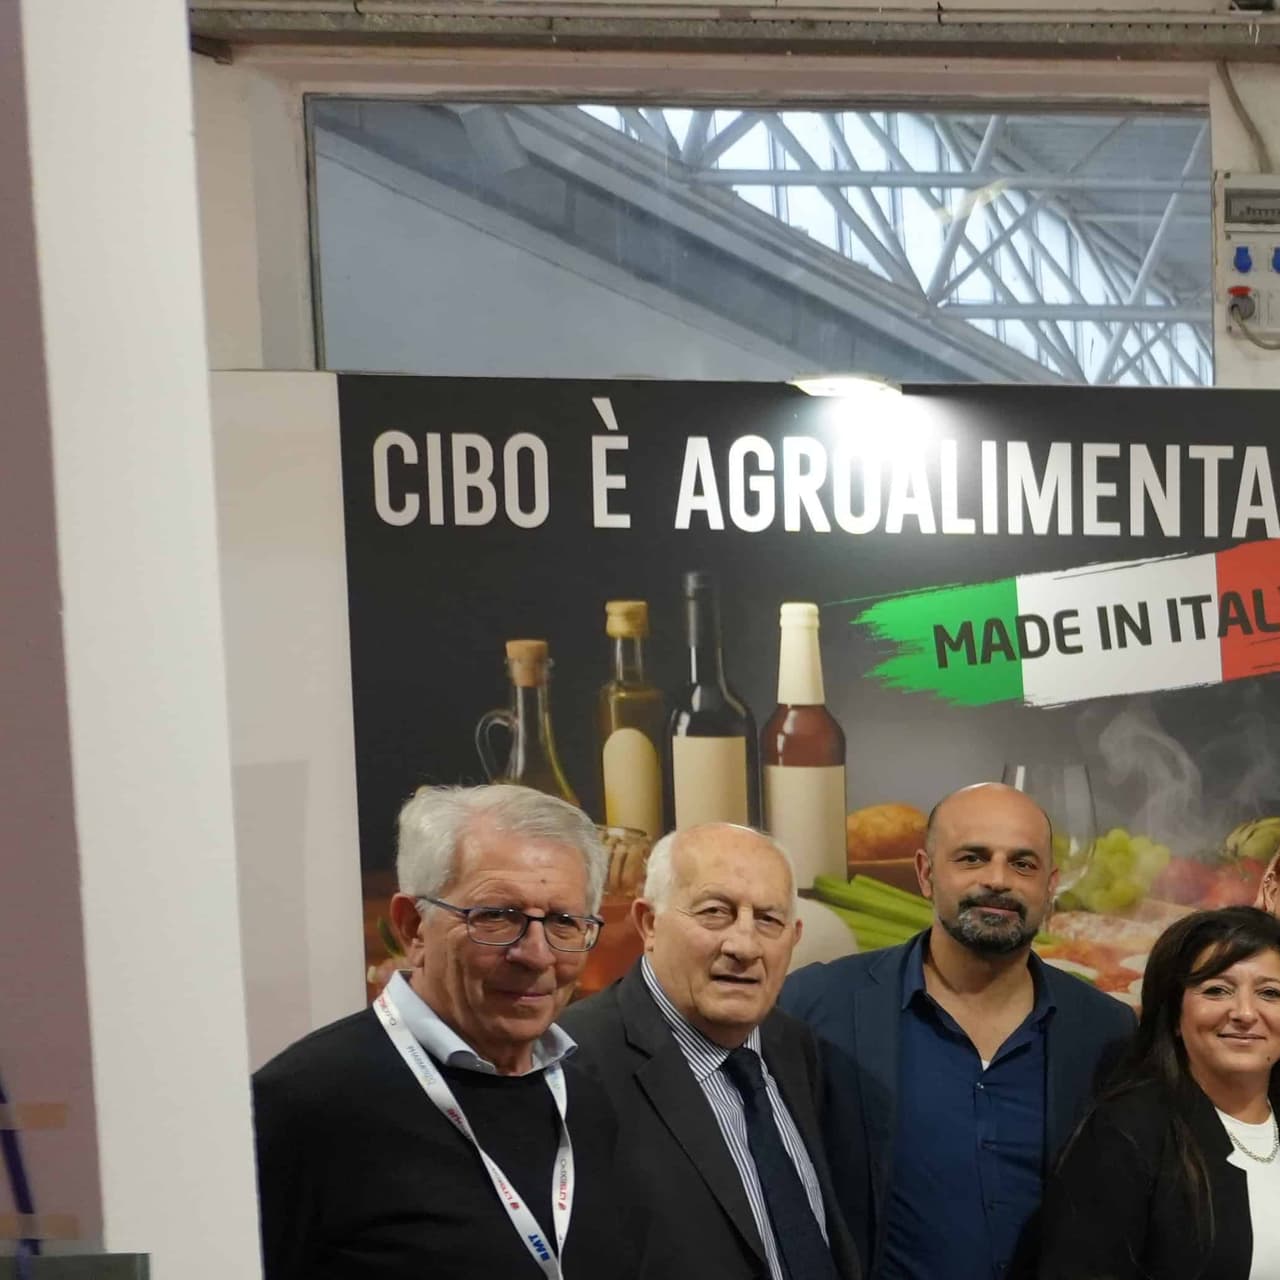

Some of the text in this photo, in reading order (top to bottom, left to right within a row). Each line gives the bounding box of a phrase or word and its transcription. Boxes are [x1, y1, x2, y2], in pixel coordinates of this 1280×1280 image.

[373, 430, 549, 529] CIBO
[591, 397, 631, 529] È
[930, 609, 1084, 670] MADE
[1095, 600, 1155, 652] IN
[528, 1233, 550, 1262] BMT
